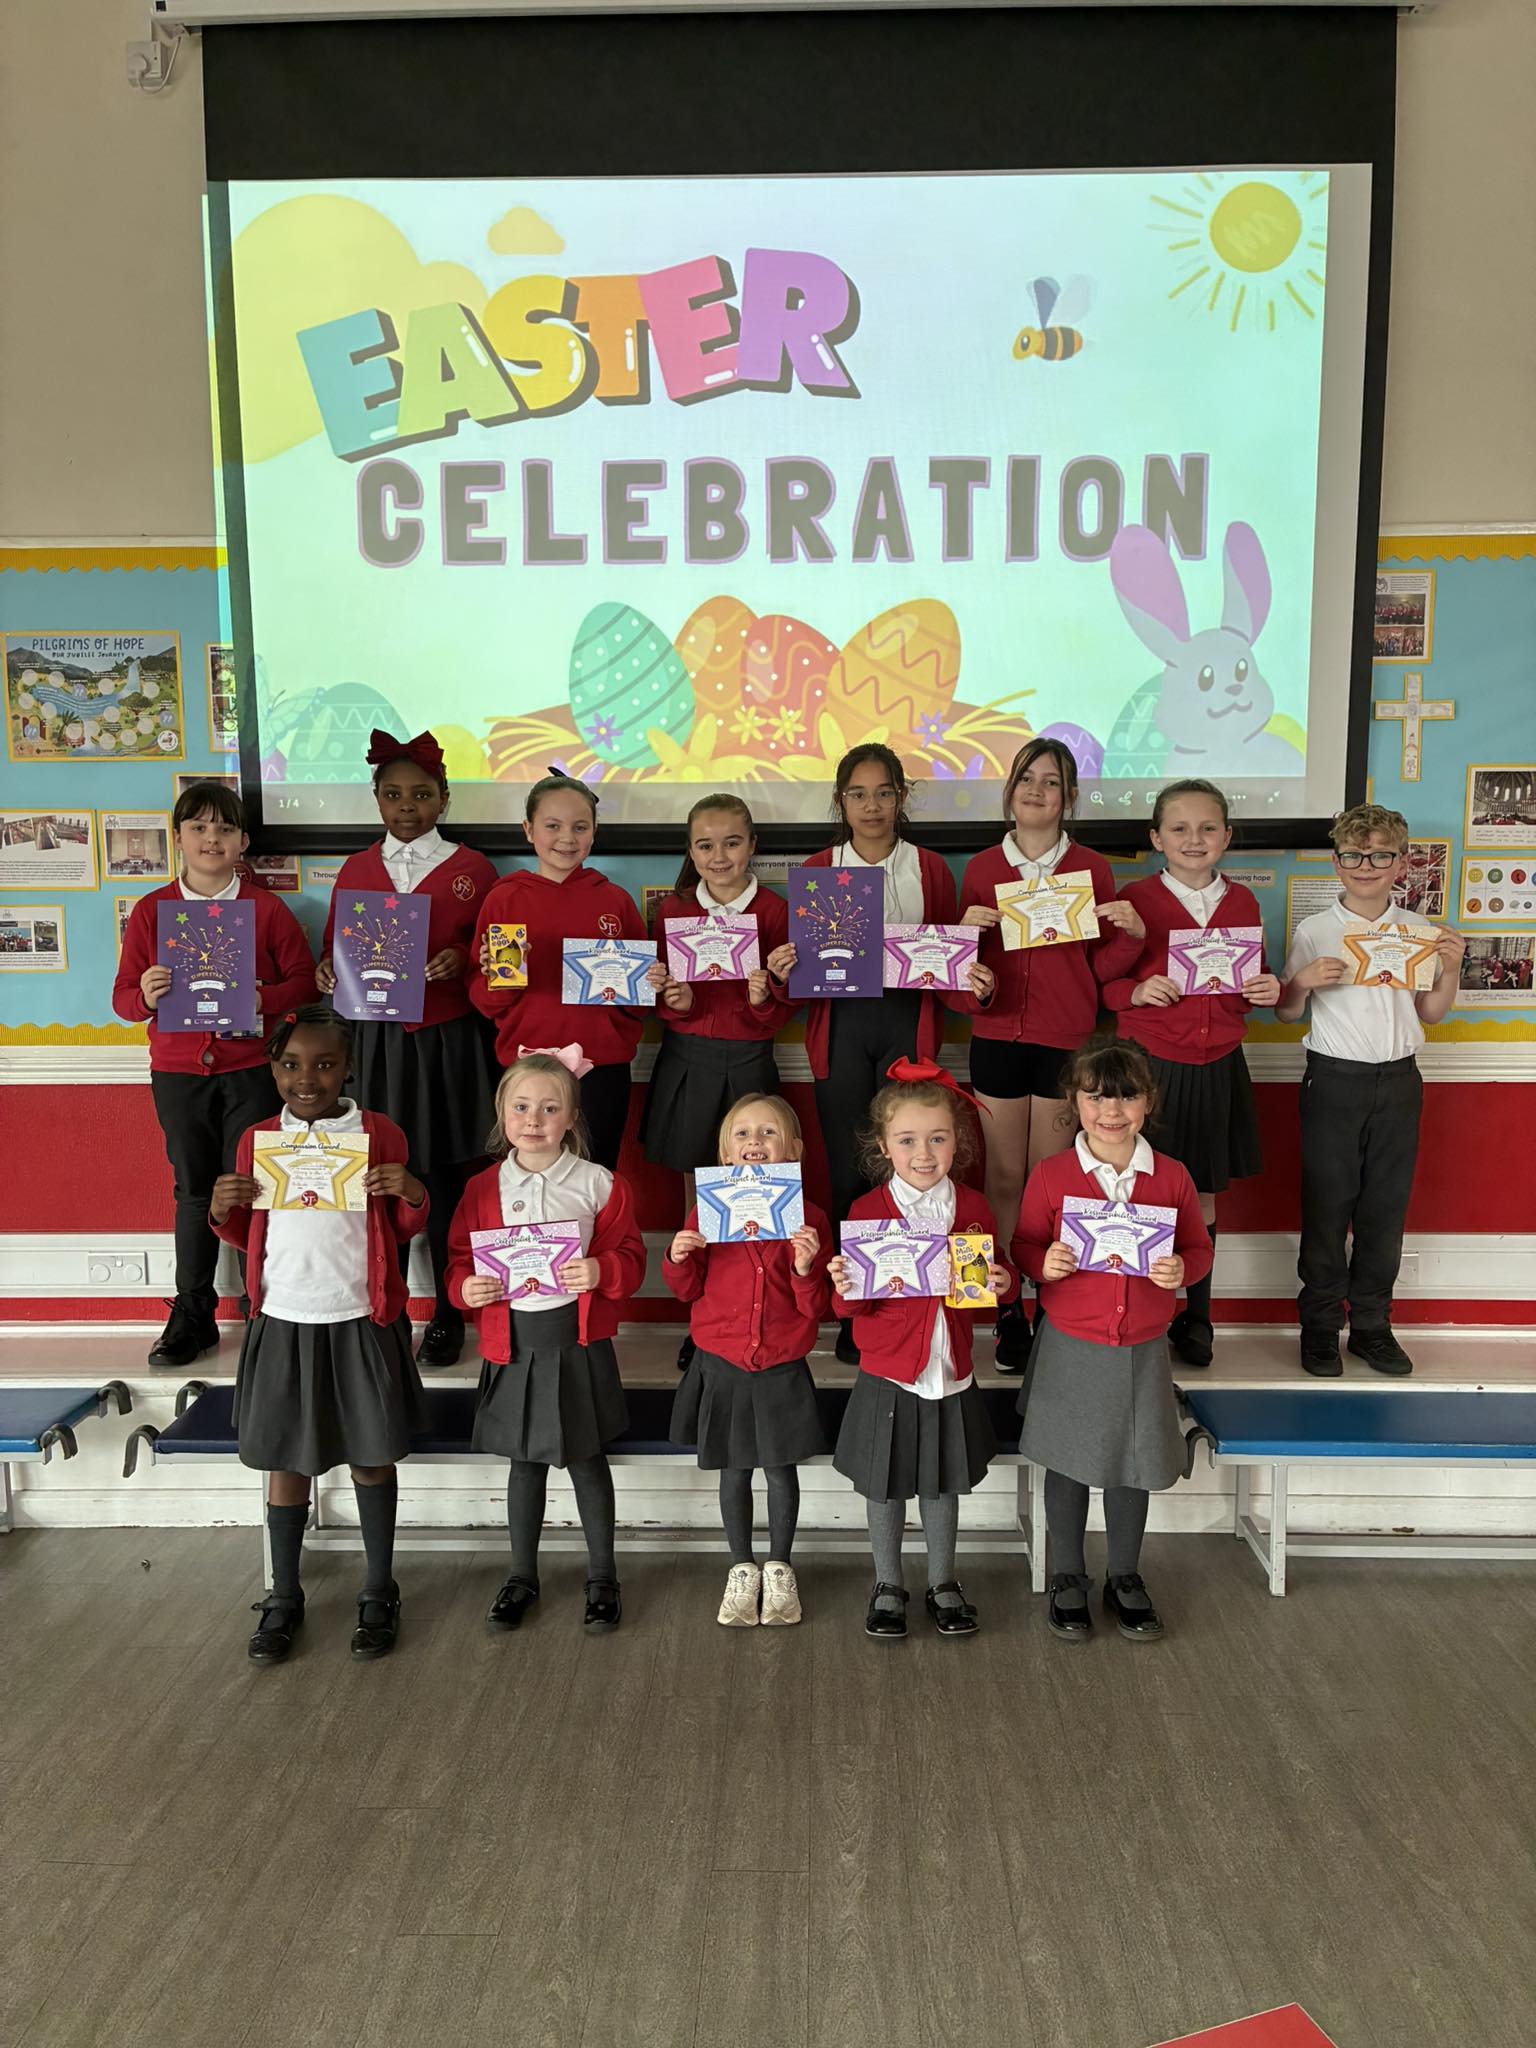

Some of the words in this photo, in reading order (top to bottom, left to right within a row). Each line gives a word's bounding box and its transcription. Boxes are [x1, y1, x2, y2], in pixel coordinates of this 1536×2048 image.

[297, 248, 861, 464] EASTER
[356, 453, 1210, 567] CELEBRATION
[32, 637, 90, 650] PILGRIMS
[94, 637, 110, 650] OF
[113, 637, 145, 650] HOPE
[312, 871, 337, 879] Throug
[1253, 874, 1272, 882] hope
[1018, 887, 1048, 896] Compassion
[1049, 882, 1068, 891] Award
[281, 1142, 317, 1151] Compassion
[318, 1142, 340, 1150] Award
[724, 1174, 749, 1184] Respect
[751, 1173, 771, 1182] Award
[1084, 1208, 1133, 1220] Responsibility
[1135, 1215, 1157, 1223] Award
[861, 1229, 908, 1238] Responsibility
[909, 1228, 929, 1236] Award
[955, 1245, 973, 1255] Mini
[957, 1253, 976, 1262] eggs
